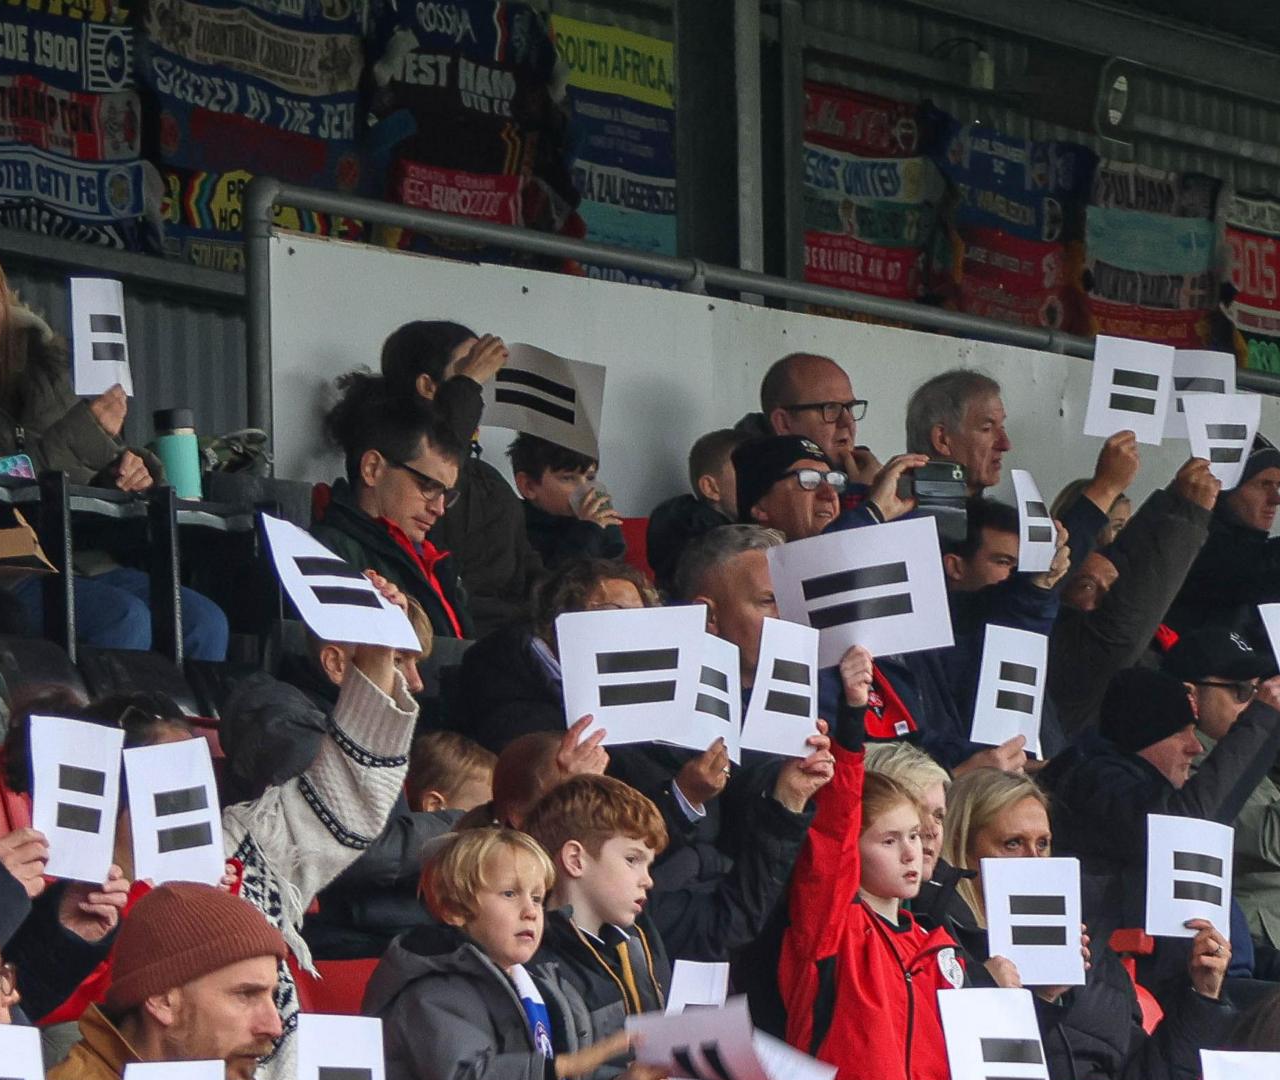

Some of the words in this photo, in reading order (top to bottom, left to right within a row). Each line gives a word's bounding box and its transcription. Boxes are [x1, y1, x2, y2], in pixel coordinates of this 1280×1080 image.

[33, 29, 80, 73] 1900
[556, 32, 608, 78] SOUTH
[458, 57, 517, 101] HAM
[35, 162, 71, 202] CITY
[75, 175, 97, 207] FC
